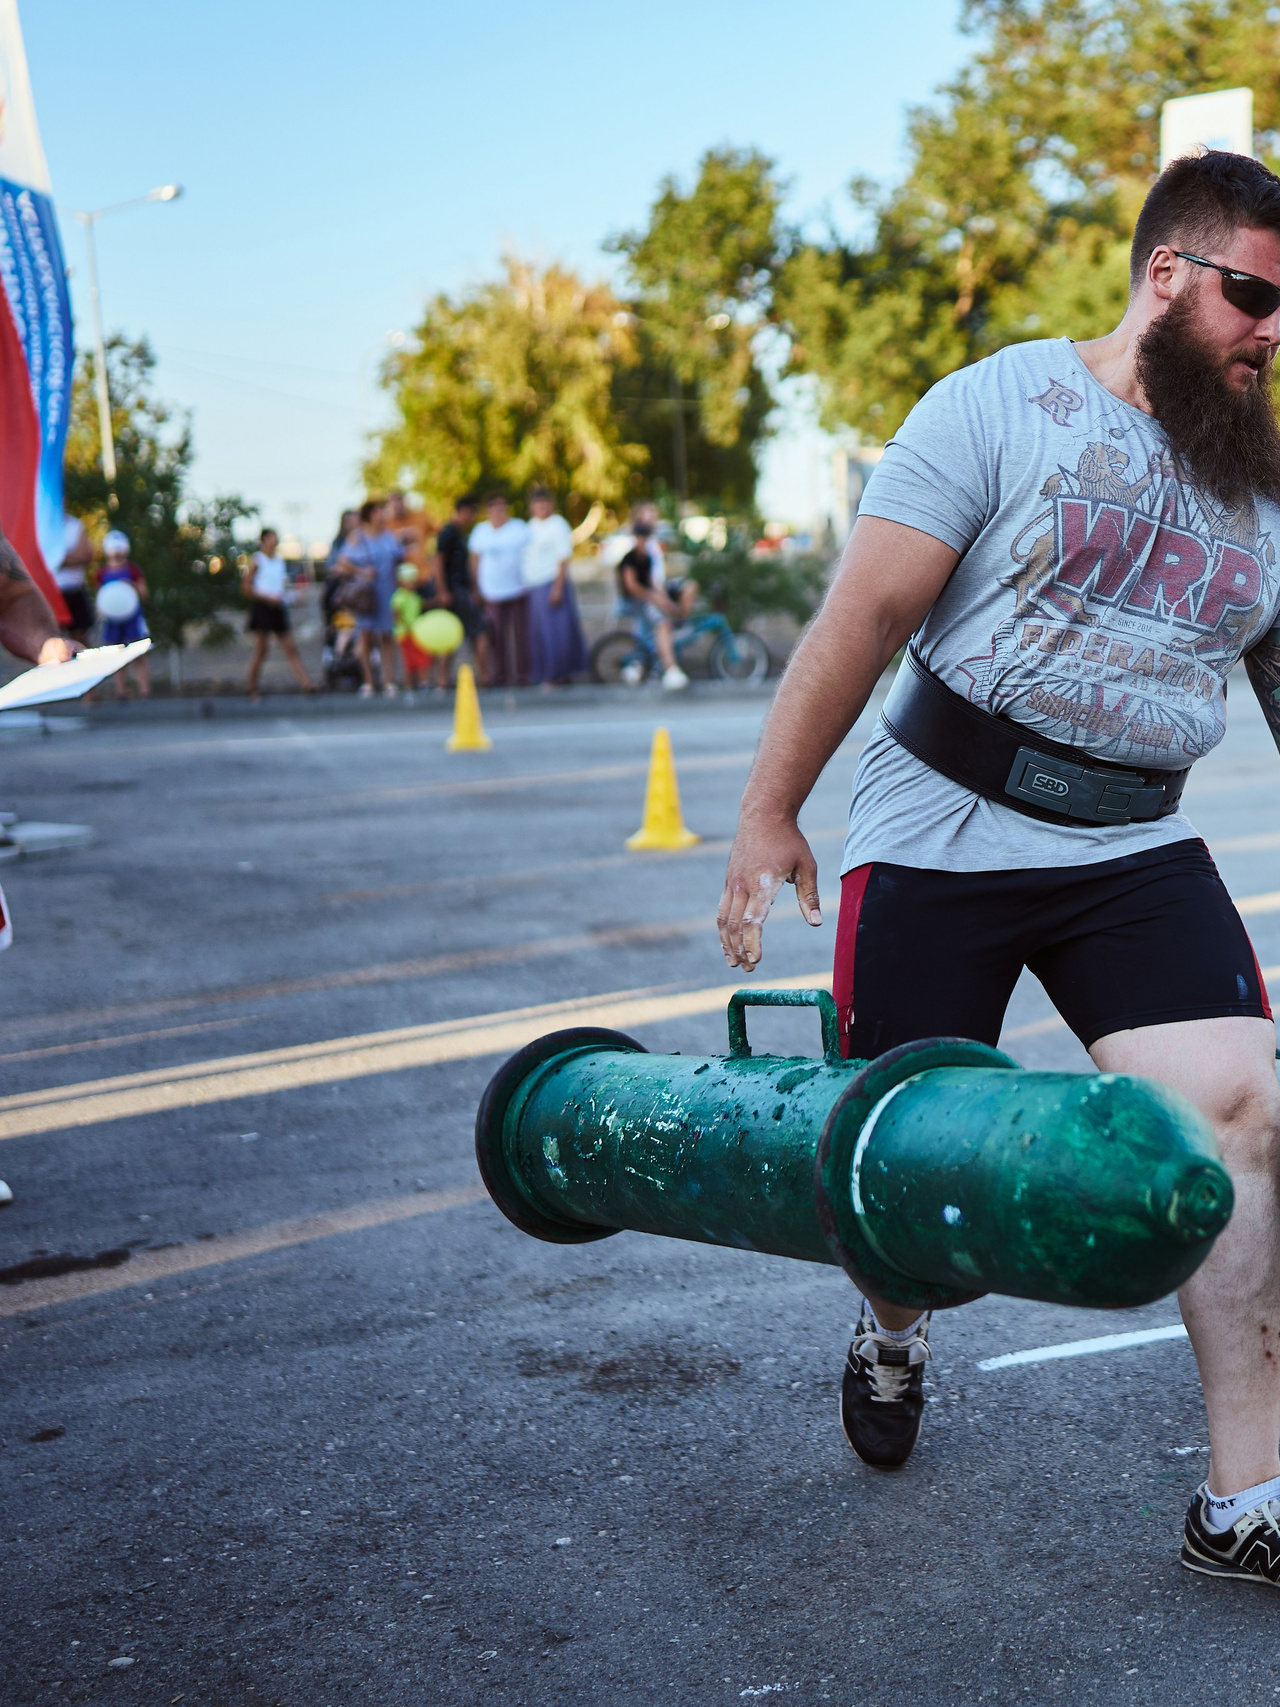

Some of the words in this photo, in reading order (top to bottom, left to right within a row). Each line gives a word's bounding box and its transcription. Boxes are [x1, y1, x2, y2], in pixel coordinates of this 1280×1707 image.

[1053, 496, 1265, 634] WRP
[1117, 617, 1137, 629] SINCE
[1137, 622, 1153, 633] 2014
[1020, 624, 1216, 701] FEDERATION
[1129, 678, 1150, 691] AD
[1033, 775, 1068, 795] SBD
